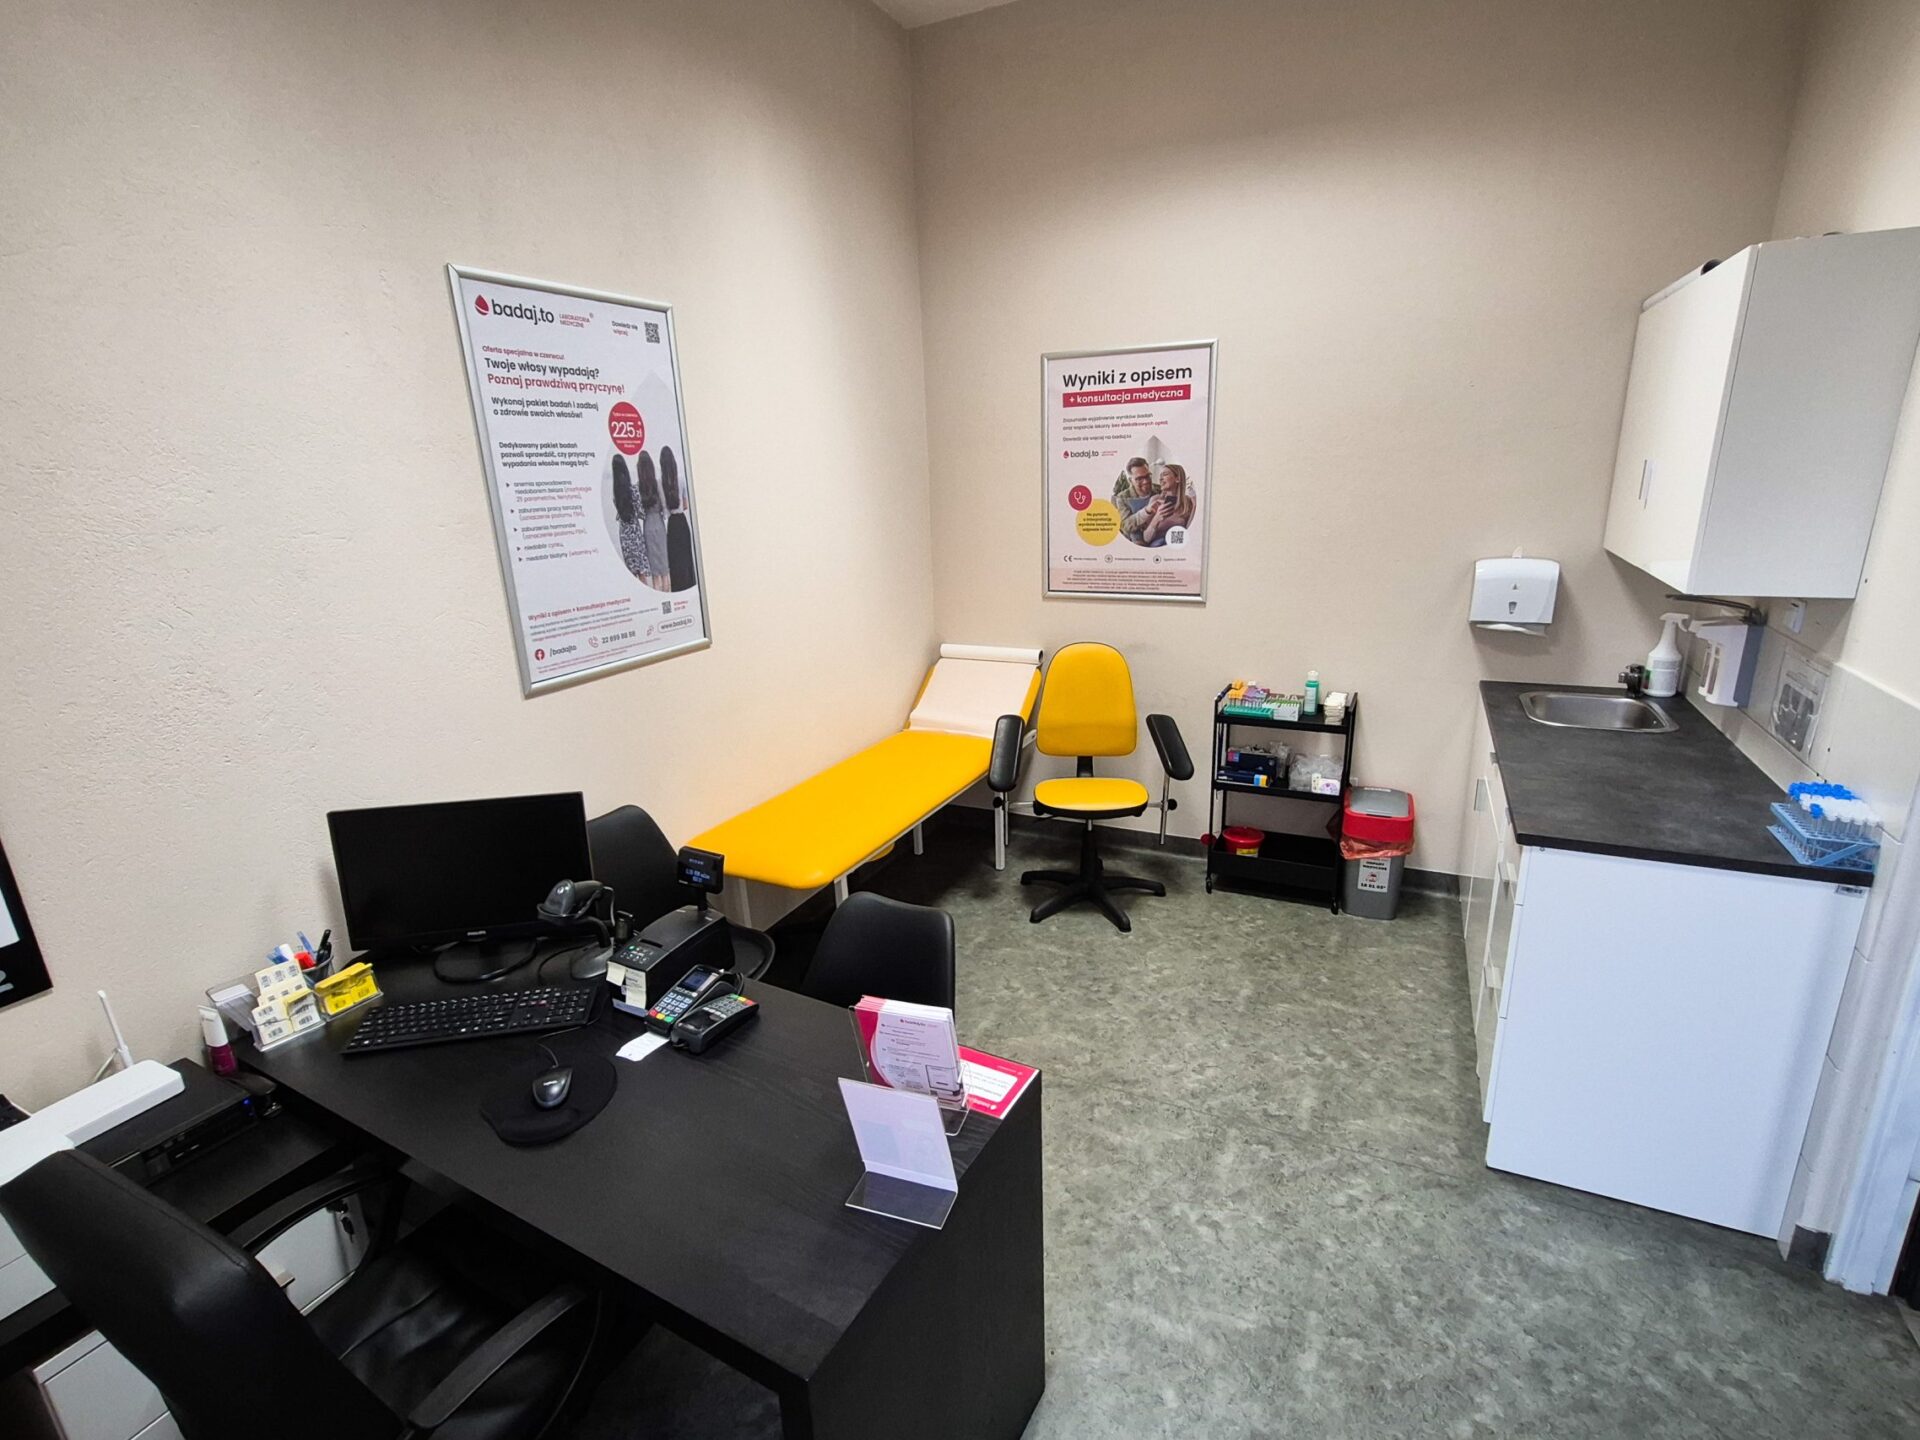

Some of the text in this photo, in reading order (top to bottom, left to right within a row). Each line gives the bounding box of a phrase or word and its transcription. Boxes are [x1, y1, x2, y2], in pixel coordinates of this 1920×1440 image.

[492, 299, 555, 325] badaj.to
[482, 345, 502, 354] Oferta
[504, 348, 533, 358] specjalna
[484, 358, 600, 380] Twoje włosy wypadają?
[487, 374, 625, 395] Poznaj prawdziwą przyczynę!
[1063, 367, 1193, 391] Wyniki z opisem
[1077, 392, 1131, 404] konsultacja
[1133, 389, 1183, 401] medyczna
[491, 397, 525, 409] Wykonaj
[526, 399, 549, 408] pakiet
[550, 400, 572, 409] badań
[576, 402, 599, 412] zadbaj
[500, 409, 529, 417] zdrowie
[530, 410, 555, 418] swoich
[556, 411, 583, 419] włosów!
[612, 422, 636, 438] 225
[499, 442, 539, 450] Dedykowany
[1071, 450, 1099, 459] badaj.to
[503, 460, 537, 468] wypadania
